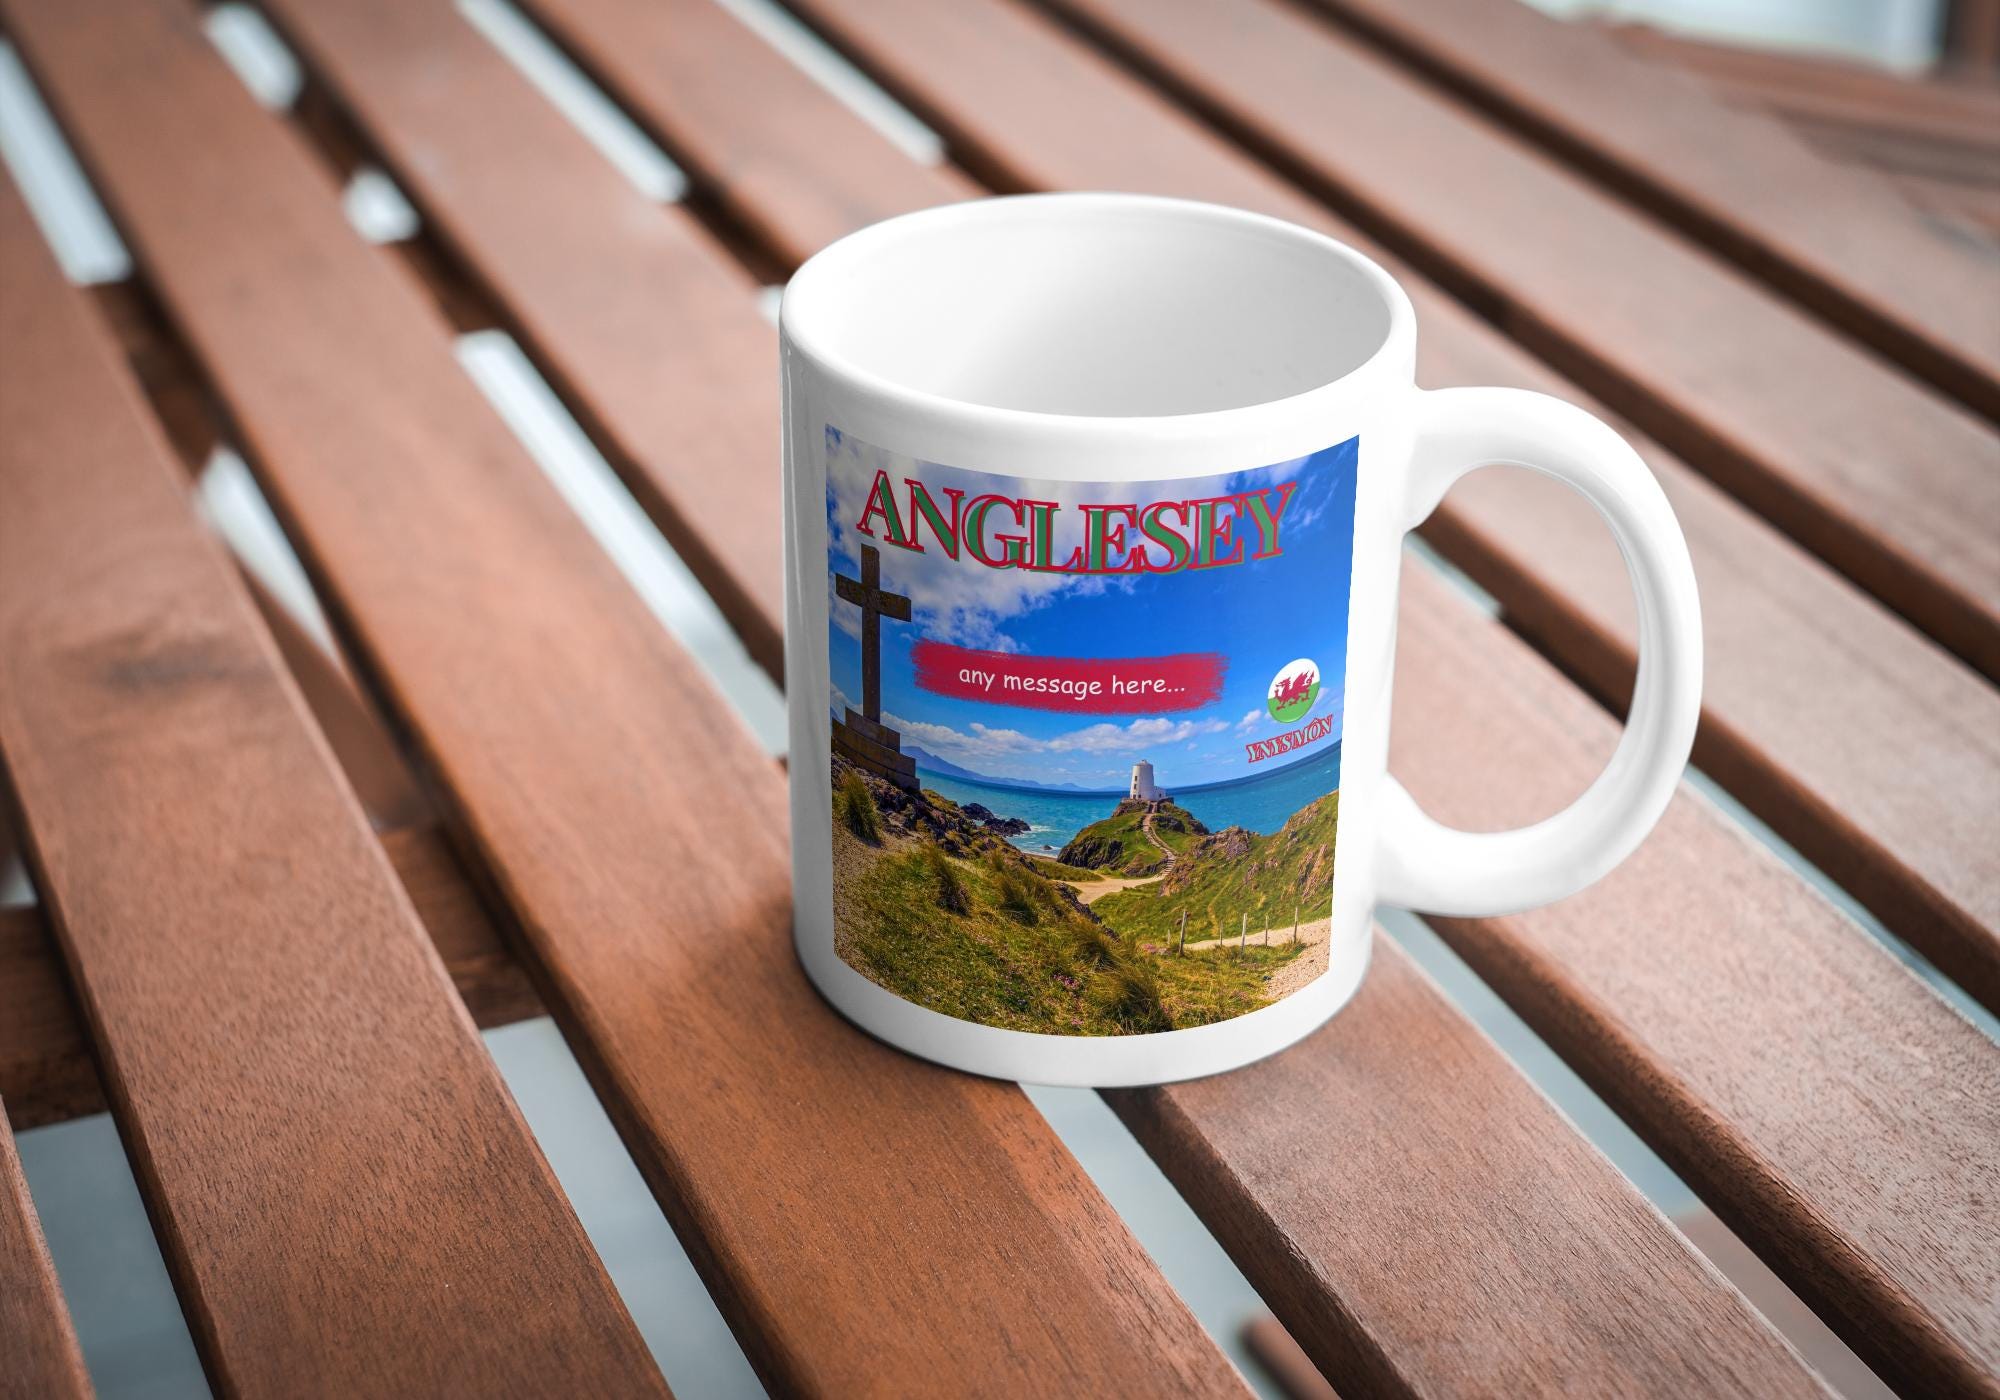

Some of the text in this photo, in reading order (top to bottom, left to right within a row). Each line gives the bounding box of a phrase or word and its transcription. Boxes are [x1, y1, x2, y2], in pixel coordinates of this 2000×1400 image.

[856, 469, 1298, 575] ANGLESEY
[959, 668, 1186, 701] any message here...
